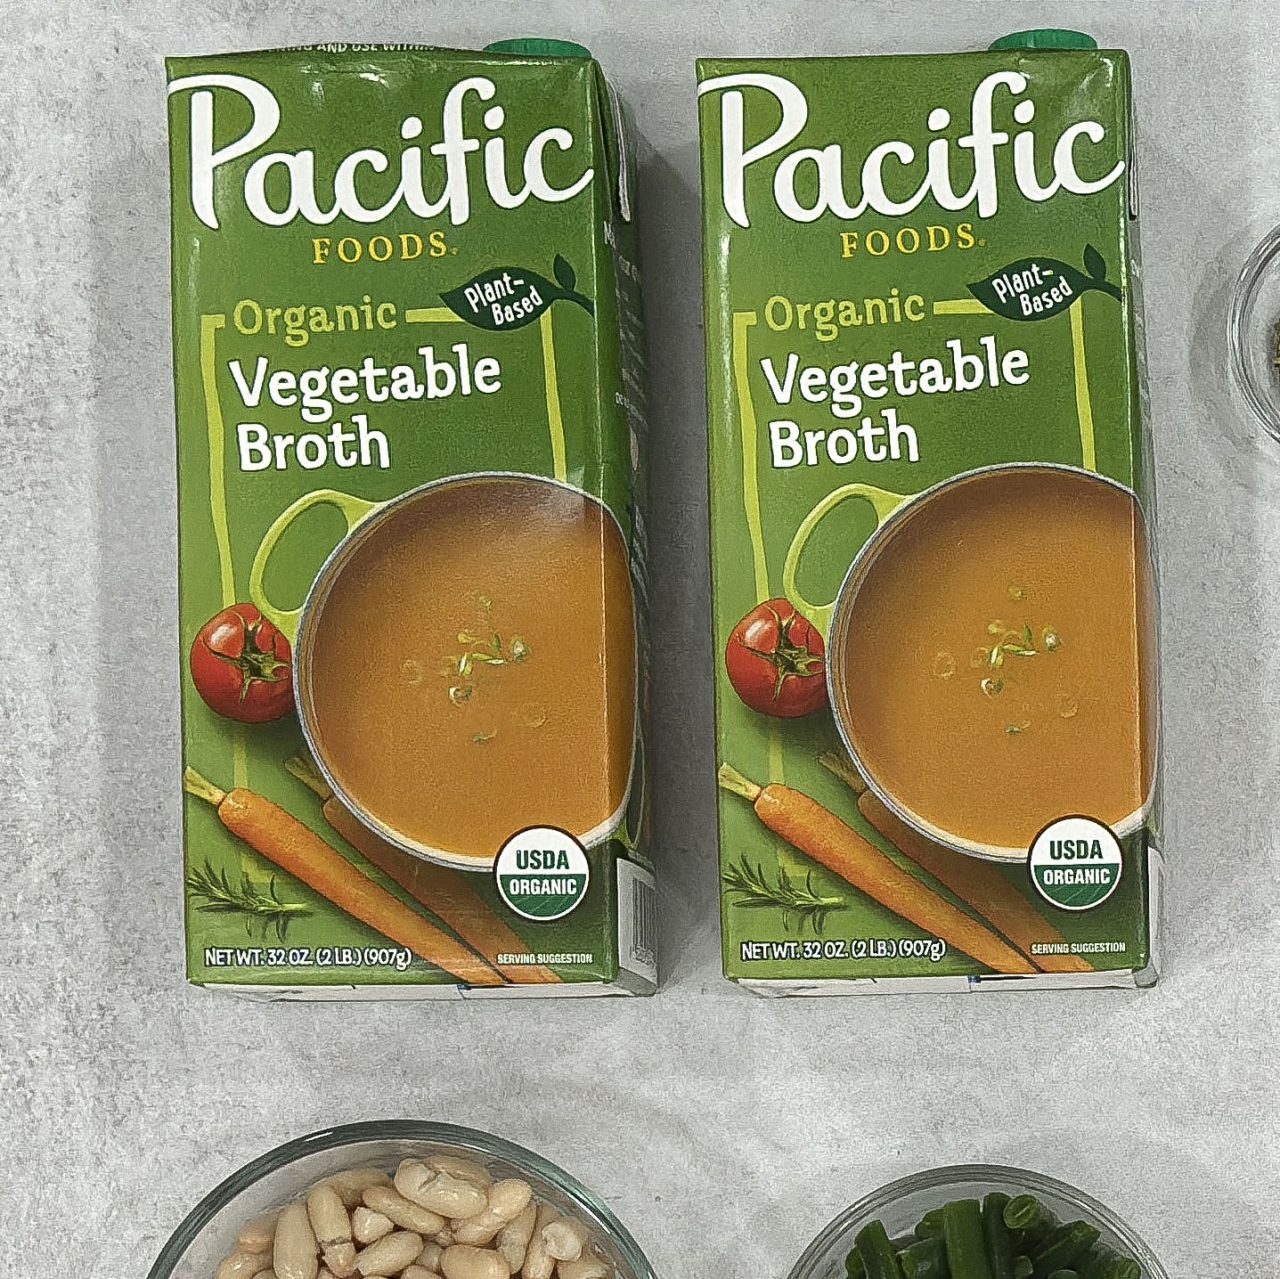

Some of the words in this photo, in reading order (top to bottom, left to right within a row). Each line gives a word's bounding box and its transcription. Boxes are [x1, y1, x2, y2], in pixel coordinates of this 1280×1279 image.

[167, 73, 595, 229] Pacific
[698, 71, 1126, 228] Pacific
[312, 231, 448, 264] FOODS
[840, 223, 976, 258] FOODS
[463, 272, 525, 314] Plant-
[991, 263, 1054, 304] Plant-
[1019, 275, 1074, 316] Based
[232, 295, 398, 347] Organic
[491, 284, 544, 325] Based
[764, 288, 926, 342] Organic
[229, 343, 502, 422] Vegetable
[760, 335, 1030, 419] Vegetable
[236, 413, 391, 471] Broth
[768, 408, 919, 468] Broth
[516, 849, 570, 870] USDA
[1049, 839, 1104, 860] USDA
[509, 878, 577, 895] ORGANIC
[1043, 868, 1111, 885] ORGANIC
[205, 948, 235, 966] NET
[236, 948, 265, 965] WT.
[268, 948, 286, 965] 32
[316, 947, 332, 967] (2
[335, 947, 361, 966] LB.)
[364, 947, 412, 971] (907g)
[497, 953, 536, 964] SERVING
[537, 953, 593, 964] SUGGESTION
[741, 943, 770, 960] NET
[771, 943, 800, 959] WT.
[803, 942, 821, 959] 32
[824, 942, 849, 959] OZ.
[852, 941, 867, 959] (2
[870, 940, 896, 959] LB.)
[899, 939, 946, 961] (907g)
[1031, 943, 1069, 954] SERVING
[1070, 942, 1126, 953] SUGGESTION
